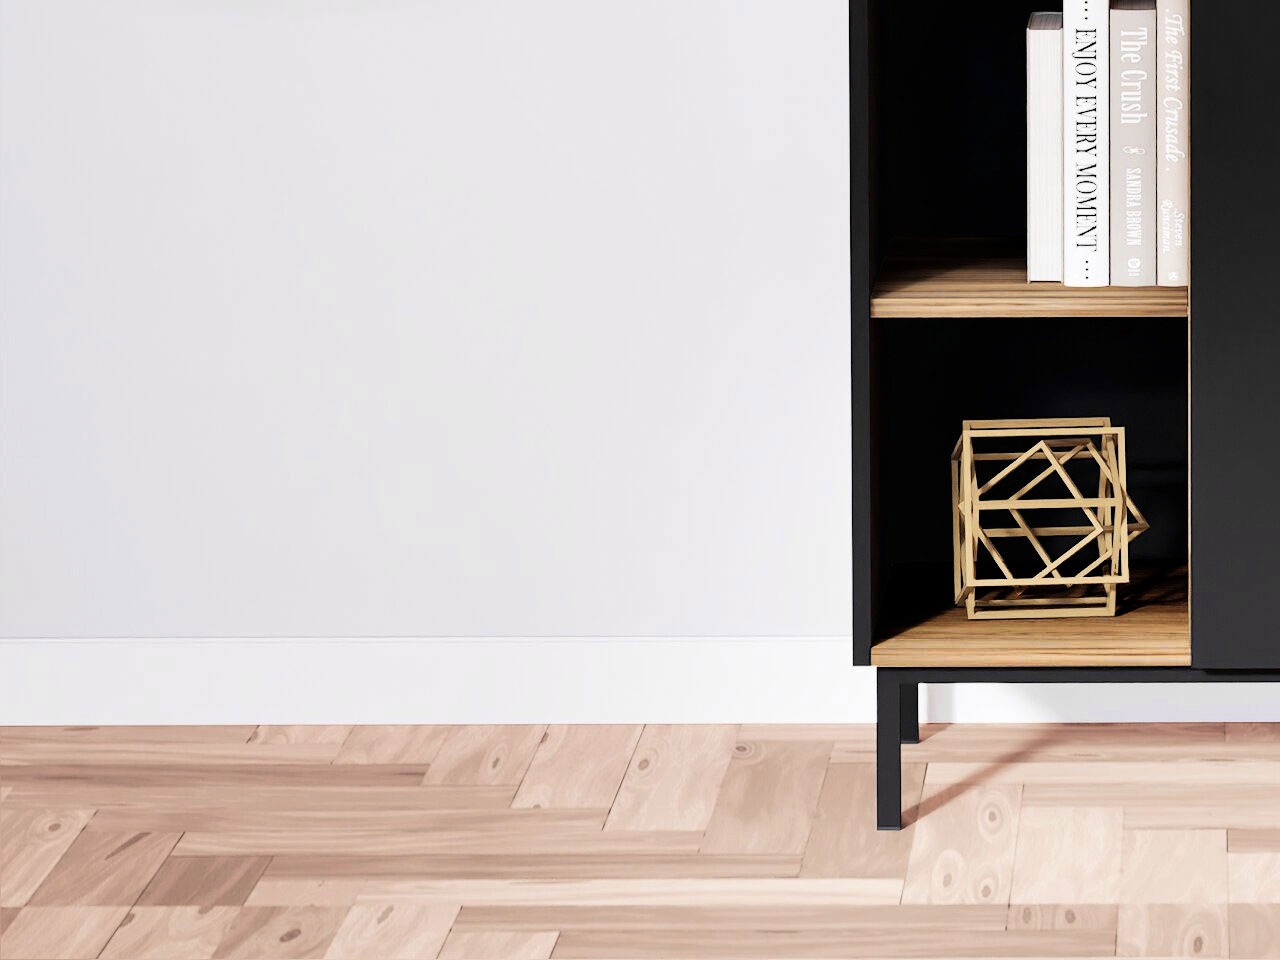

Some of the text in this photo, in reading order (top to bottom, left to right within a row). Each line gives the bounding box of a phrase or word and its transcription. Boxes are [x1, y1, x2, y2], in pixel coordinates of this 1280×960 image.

[1120, 27, 1148, 124] The Crush
[1163, 14, 1185, 163] The First Crusade
[1072, 28, 1097, 252] ENJOY EVERY MOMENT
[1126, 167, 1142, 208] SANDRA
[1126, 209, 1142, 246] BROWN
